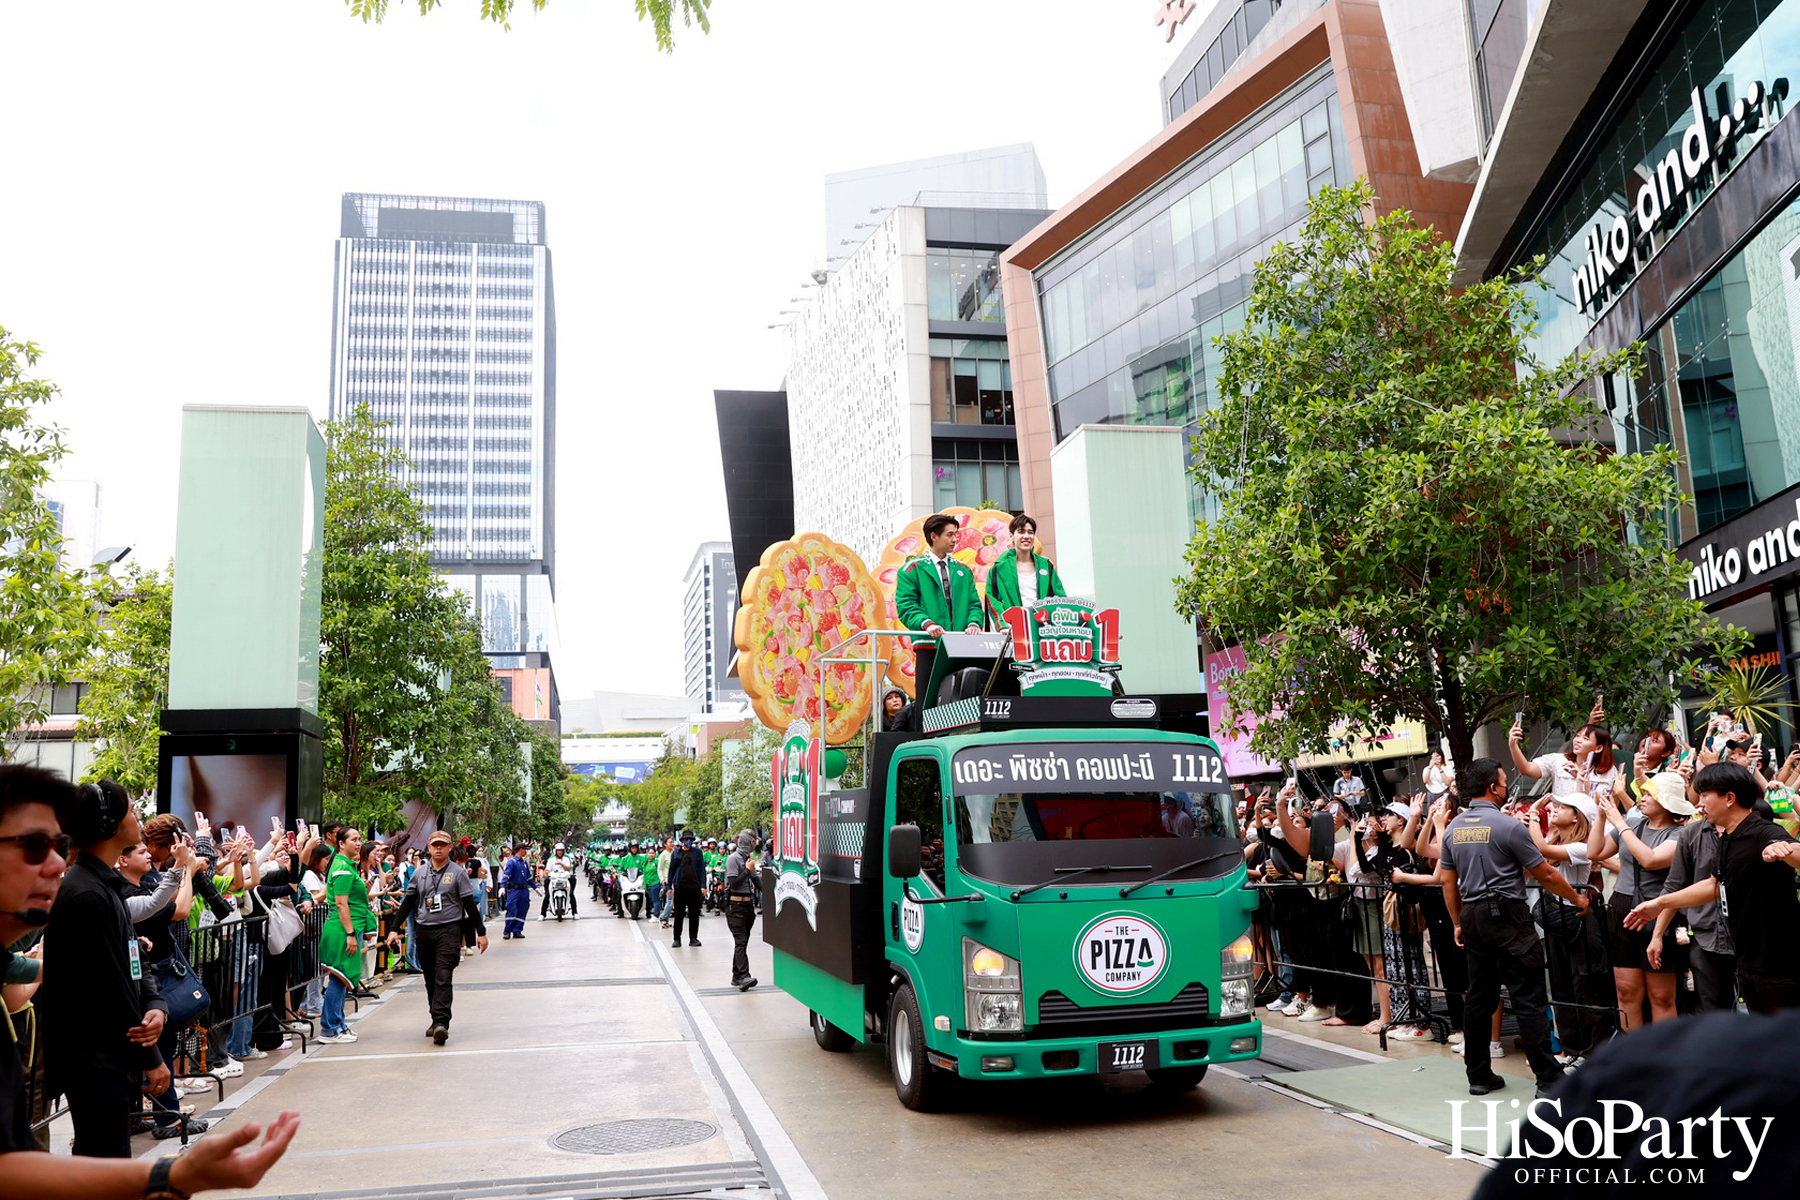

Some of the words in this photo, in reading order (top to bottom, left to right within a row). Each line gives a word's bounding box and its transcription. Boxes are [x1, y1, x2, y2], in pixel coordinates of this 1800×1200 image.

[1572, 215, 1630, 314] niko
[1688, 543, 1741, 600] niko
[1002, 606, 1032, 662] 1
[1094, 608, 1120, 662] 1
[1040, 640, 1093, 661] แถม
[984, 701, 1012, 715] 1112
[954, 758, 1004, 784] เดอะ
[1009, 751, 1070, 781] พิซซ่า
[1076, 752, 1155, 781] คอมปะนี
[1172, 754, 1223, 784] 1112
[1453, 828, 1488, 842] SUPPORT
[903, 907, 919, 934] PIZZA
[1115, 926, 1129, 936] THE
[1090, 938, 1155, 970] PIZZA
[1105, 971, 1141, 982] COMPANY
[1112, 1045, 1145, 1066] 1112
